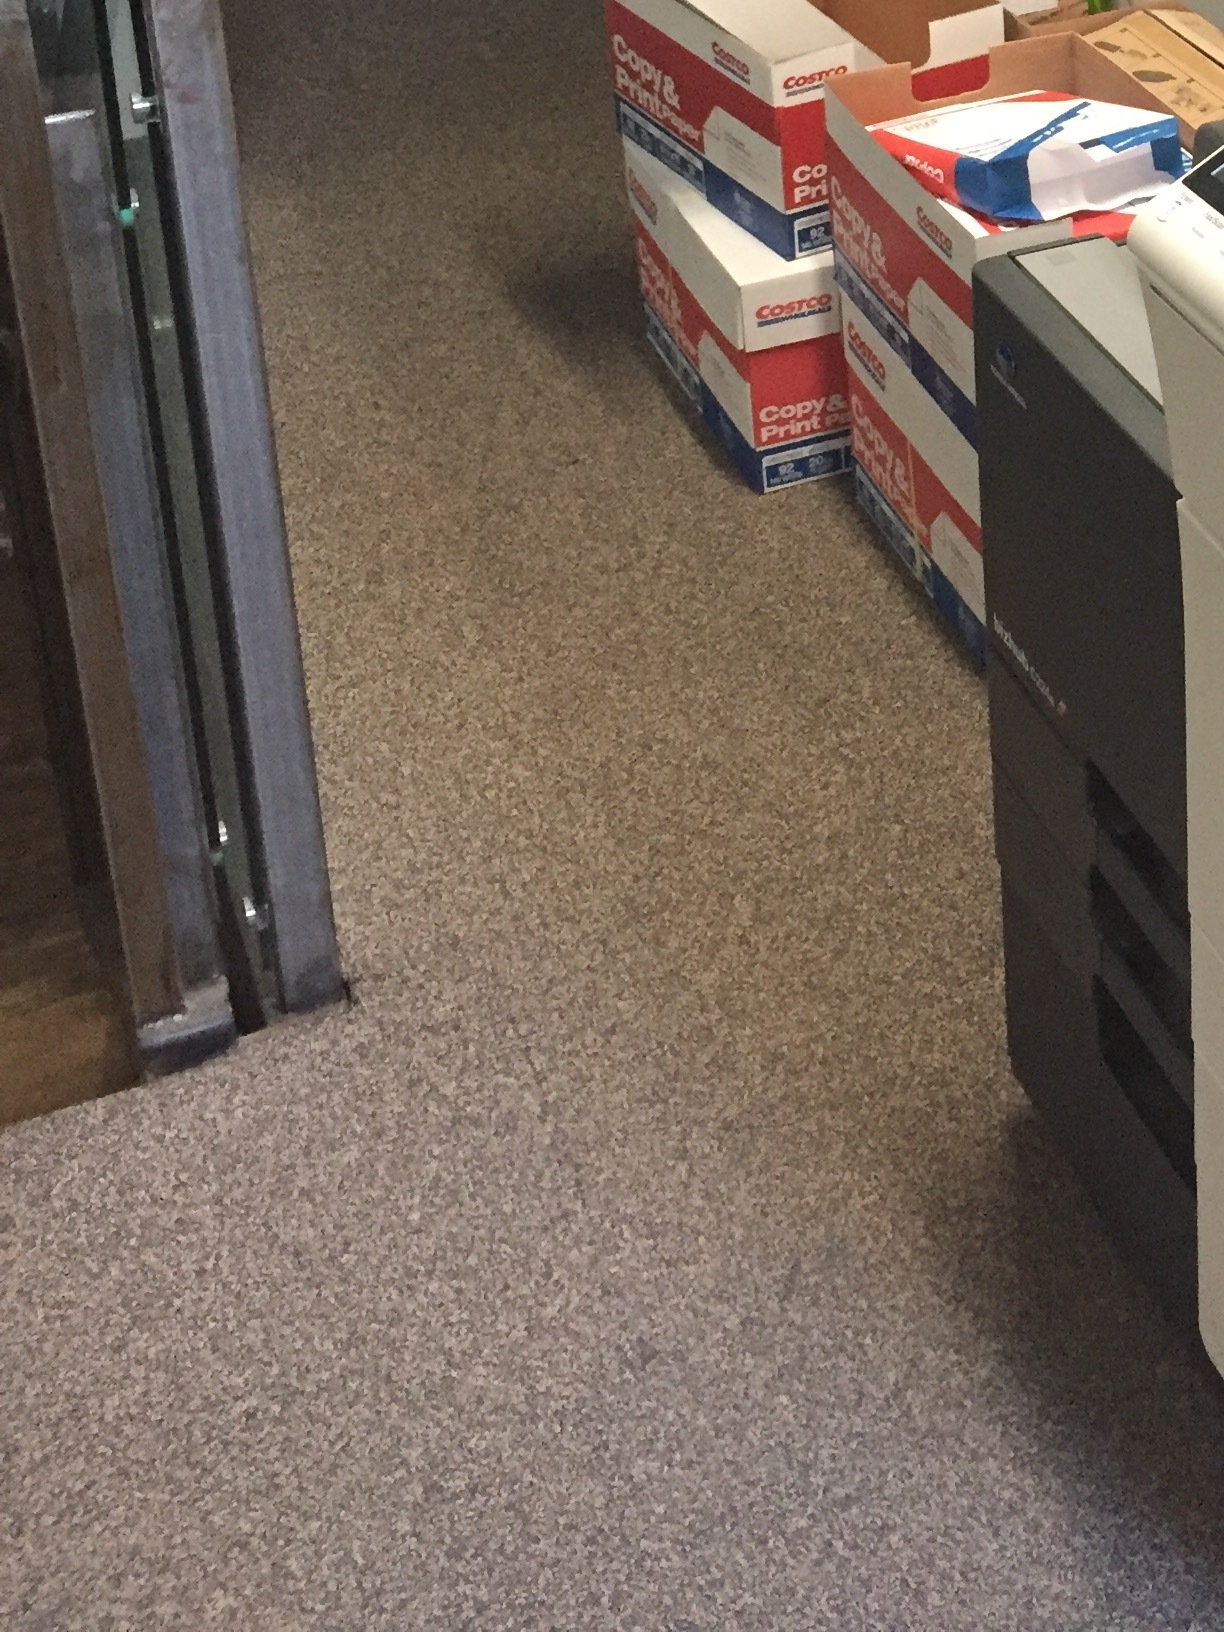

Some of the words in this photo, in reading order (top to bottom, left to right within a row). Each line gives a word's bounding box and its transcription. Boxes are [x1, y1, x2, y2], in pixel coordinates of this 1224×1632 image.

[711, 41, 749, 76] COSTCO
[783, 65, 848, 90] COSTCO
[794, 180, 827, 204] Pri
[917, 206, 953, 251] COSTCO
[755, 293, 833, 320] COSTCO
[848, 321, 886, 382] COSTCO
[760, 416, 822, 443] Print
